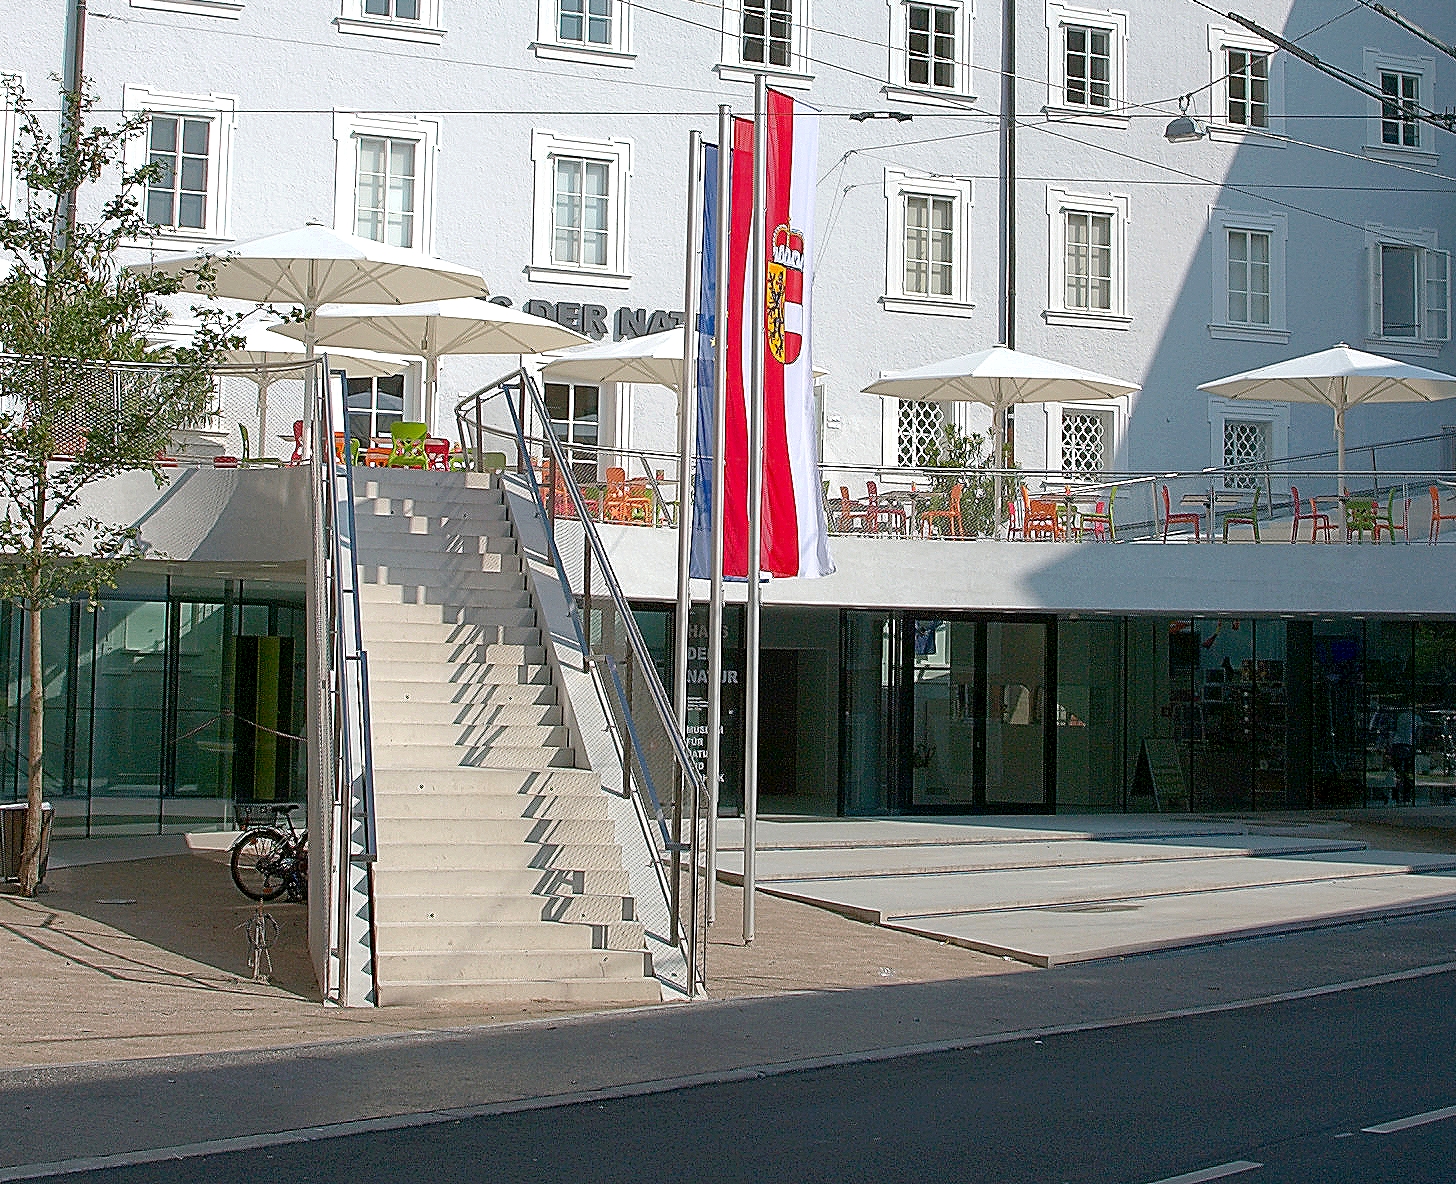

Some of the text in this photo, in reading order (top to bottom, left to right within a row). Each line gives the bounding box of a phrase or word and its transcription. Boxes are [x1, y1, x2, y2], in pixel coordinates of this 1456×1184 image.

[524, 298, 610, 338] DER
[689, 624, 729, 639] HAS
[687, 646, 707, 661] DE
